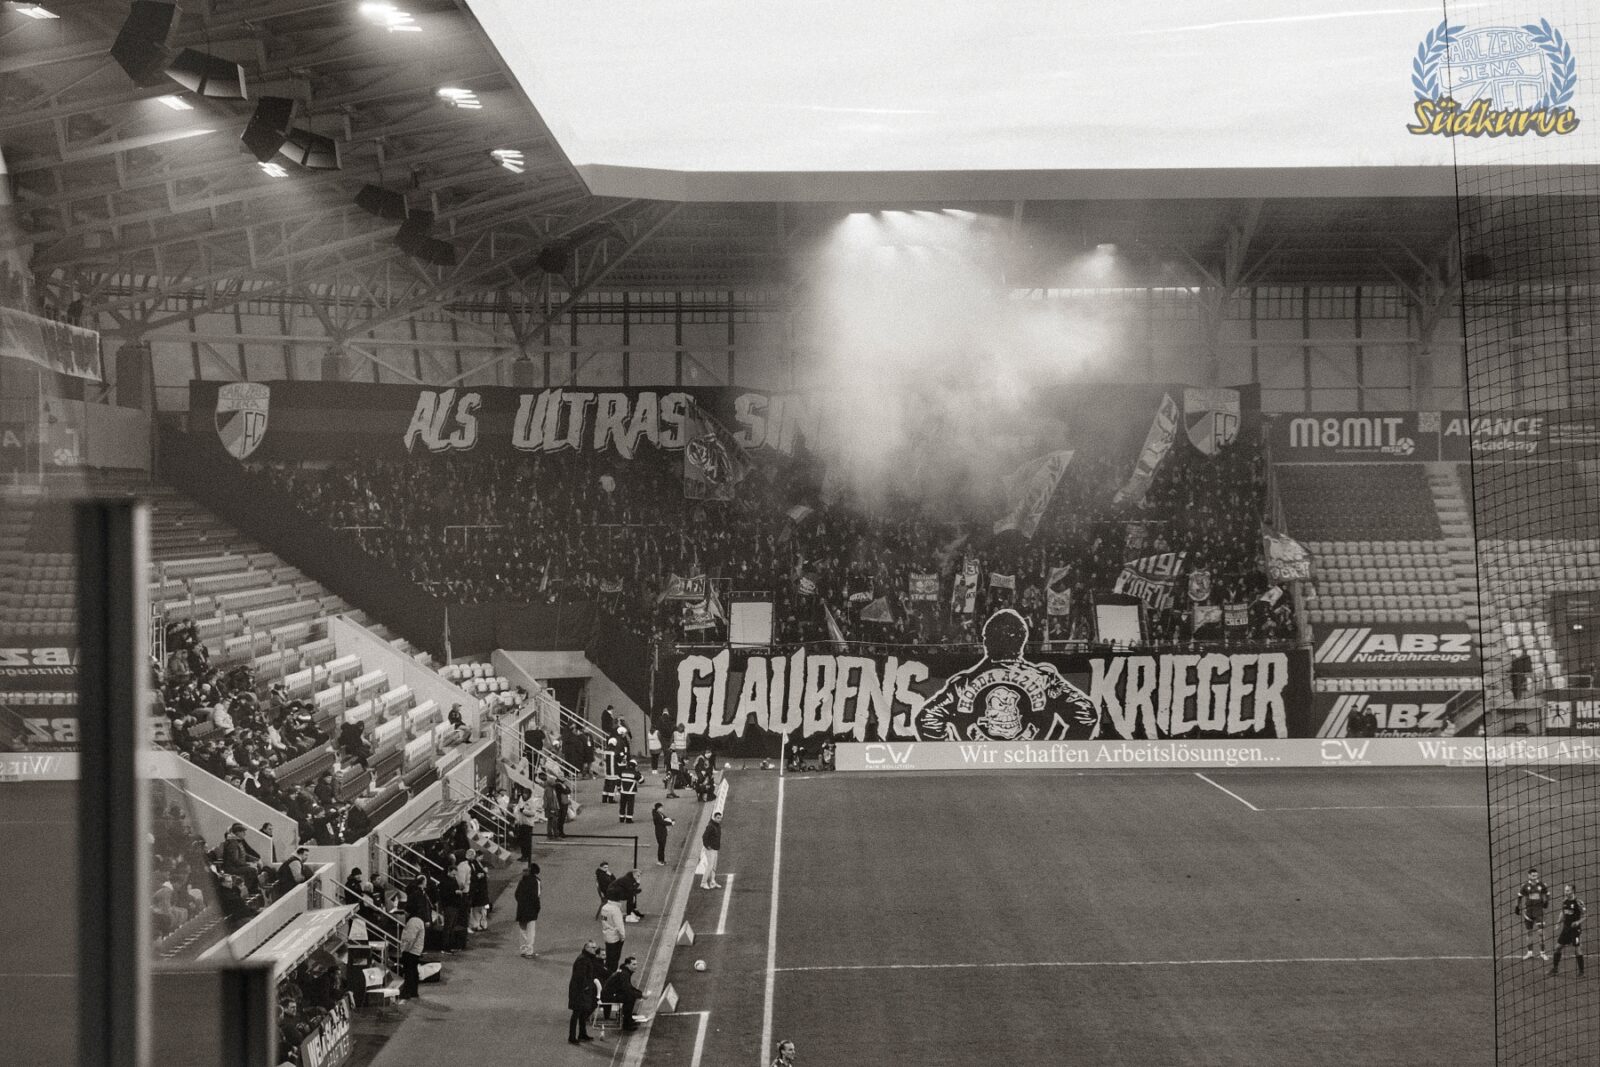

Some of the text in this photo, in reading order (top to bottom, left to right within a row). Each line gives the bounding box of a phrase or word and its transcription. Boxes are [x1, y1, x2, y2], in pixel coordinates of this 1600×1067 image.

[403, 388, 482, 453] ALS
[512, 388, 694, 460] ULTRAS
[1290, 417, 1403, 447] M8MIT
[1444, 417, 1543, 436] AVANCE
[1470, 438, 1537, 453] Academy
[1358, 634, 1472, 653] ABZ
[1352, 652, 1471, 663] Nutzfahrzeuge
[676, 647, 929, 742] GLAUBENS
[1089, 653, 1288, 740] KRIEGER
[865, 744, 914, 764] CW
[960, 743, 1281, 766] Wir schaffen Arbeitslösungen...
[1321, 740, 1370, 760] CW
[1418, 741, 1457, 760] Wir
[1463, 740, 1548, 760] schaffen
